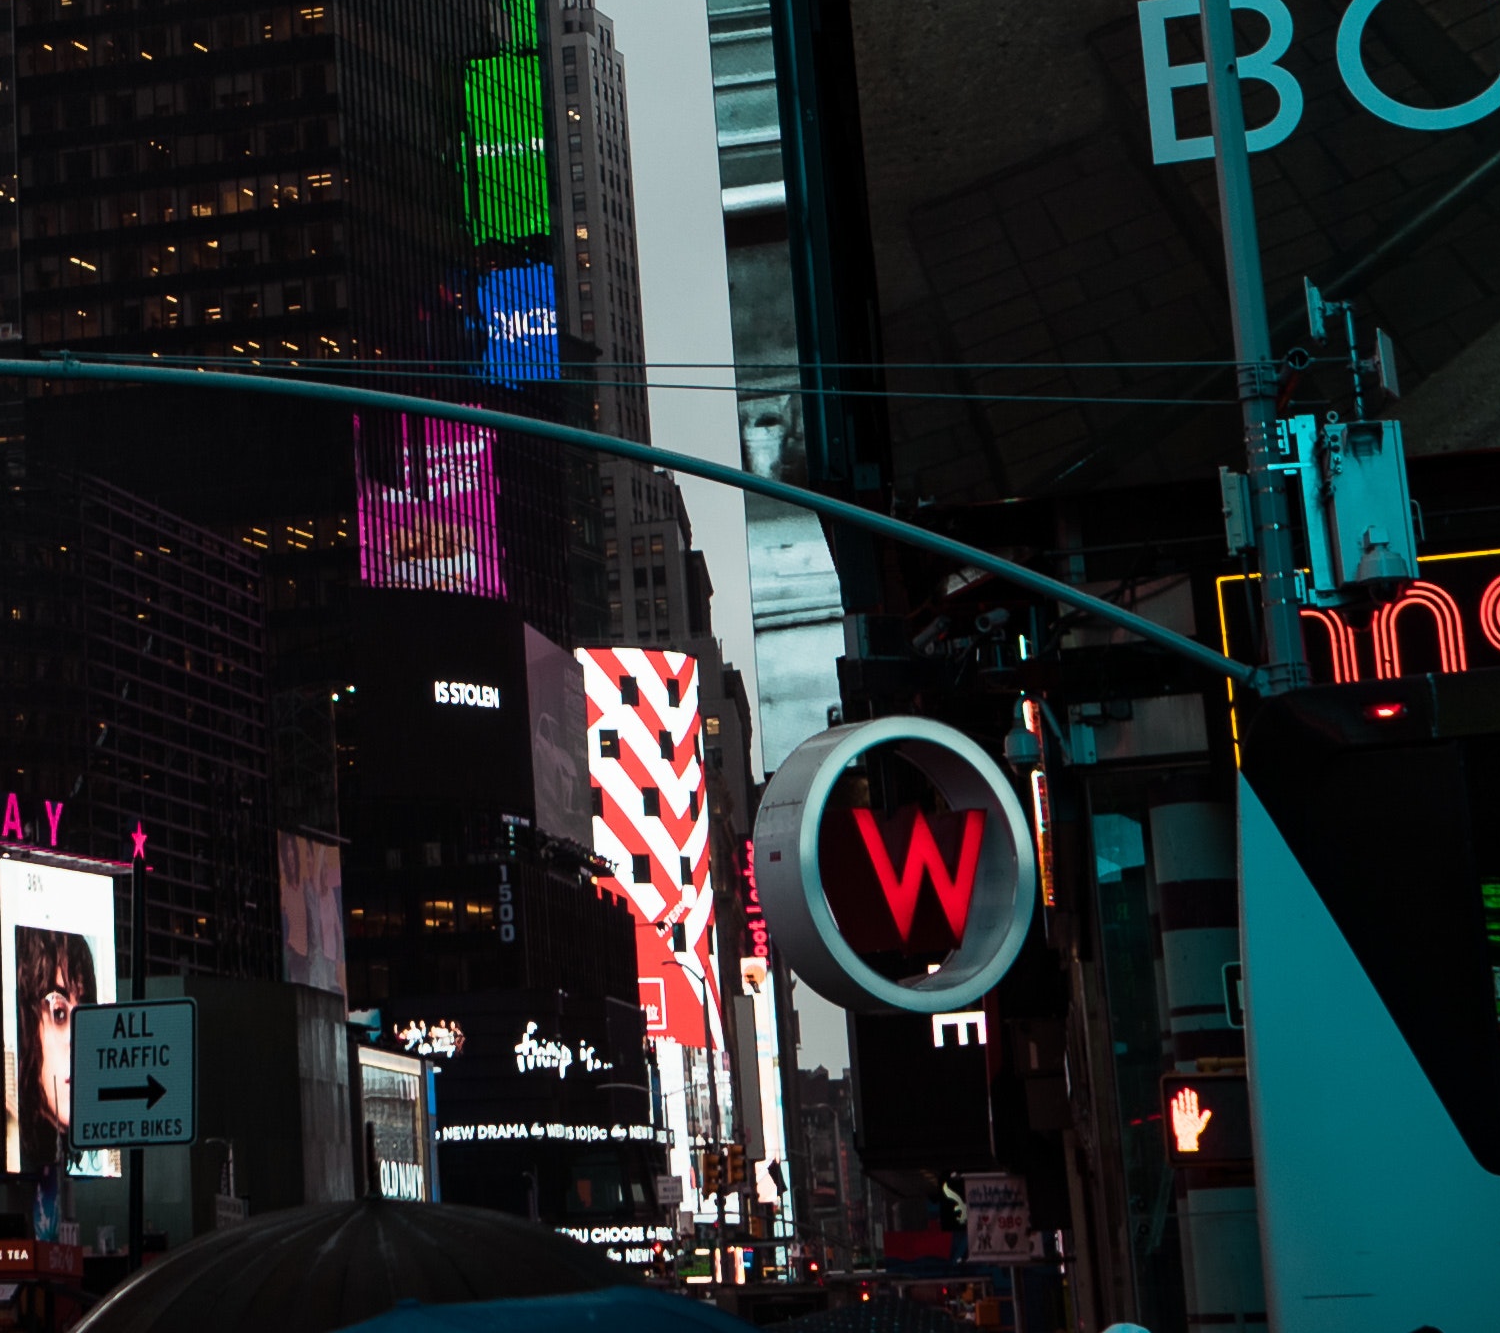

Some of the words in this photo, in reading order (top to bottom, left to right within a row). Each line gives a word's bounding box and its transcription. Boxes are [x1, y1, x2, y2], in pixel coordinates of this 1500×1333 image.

[434, 681, 449, 704] IS
[449, 682, 500, 709] STOLEN
[851, 808, 986, 949] W
[112, 1011, 153, 1039] ALL
[97, 1045, 170, 1069] TRAFFIC
[82, 1121, 134, 1139] EXCEPT
[141, 1119, 182, 1136] BIKES
[442, 1125, 475, 1141] NEW
[477, 1124, 528, 1140] DRAMA
[381, 1159, 398, 1197] OLD
[591, 1227, 643, 1243] CHOOSE
[8, 1249, 29, 1261] TEA
